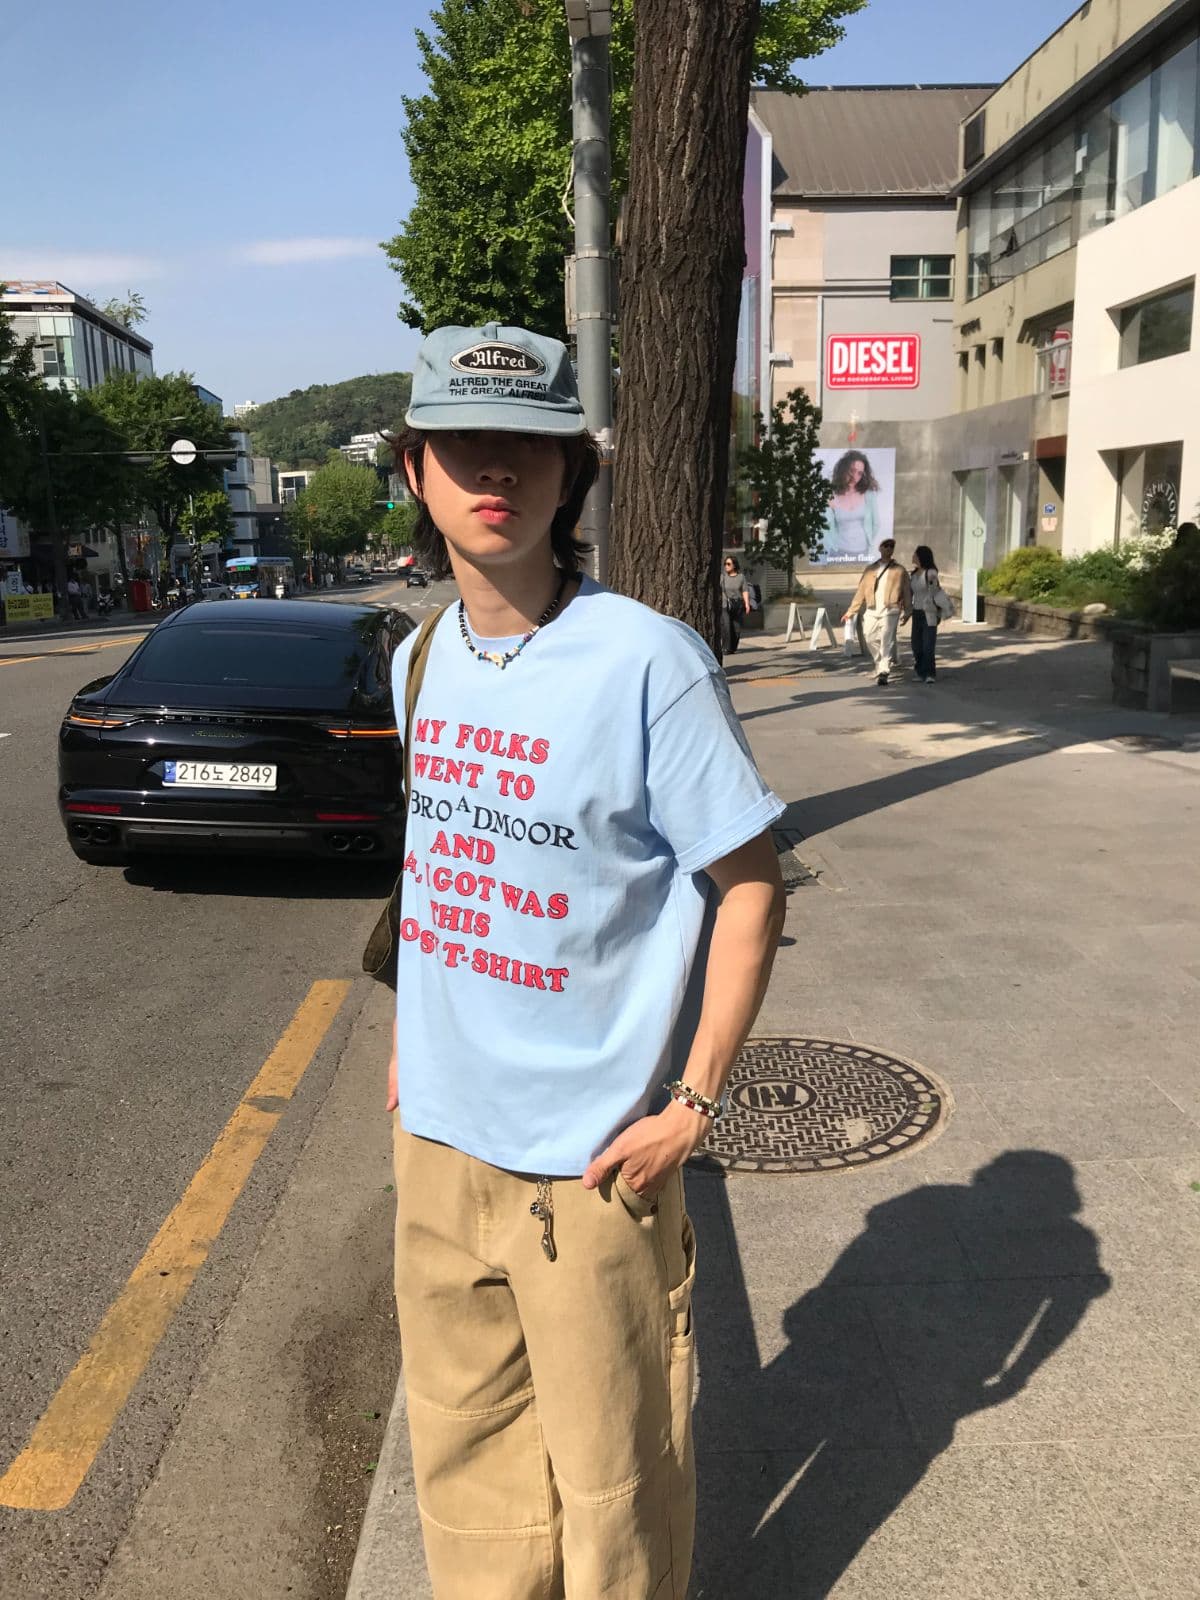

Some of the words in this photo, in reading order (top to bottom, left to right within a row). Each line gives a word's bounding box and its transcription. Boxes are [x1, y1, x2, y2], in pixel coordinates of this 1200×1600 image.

[469, 350, 527, 369] Alfred
[832, 340, 913, 374] DIESEL
[449, 377, 489, 387] ALFRED
[491, 377, 513, 387] THE
[515, 379, 548, 392] GREAT
[449, 388, 468, 396] THE
[471, 388, 504, 396] GREAT
[508, 388, 546, 400] ALFRED
[415, 718, 447, 744] MY
[455, 723, 550, 765] FOLKS
[229, 765, 272, 783] 2849
[414, 753, 484, 788] WENT
[497, 769, 535, 800] TO
[411, 790, 579, 850] BROADMOOR
[430, 830, 496, 865] AND
[433, 866, 496, 902] GOT
[501, 881, 569, 919] WAS
[442, 941, 569, 992] T-SHIRT
